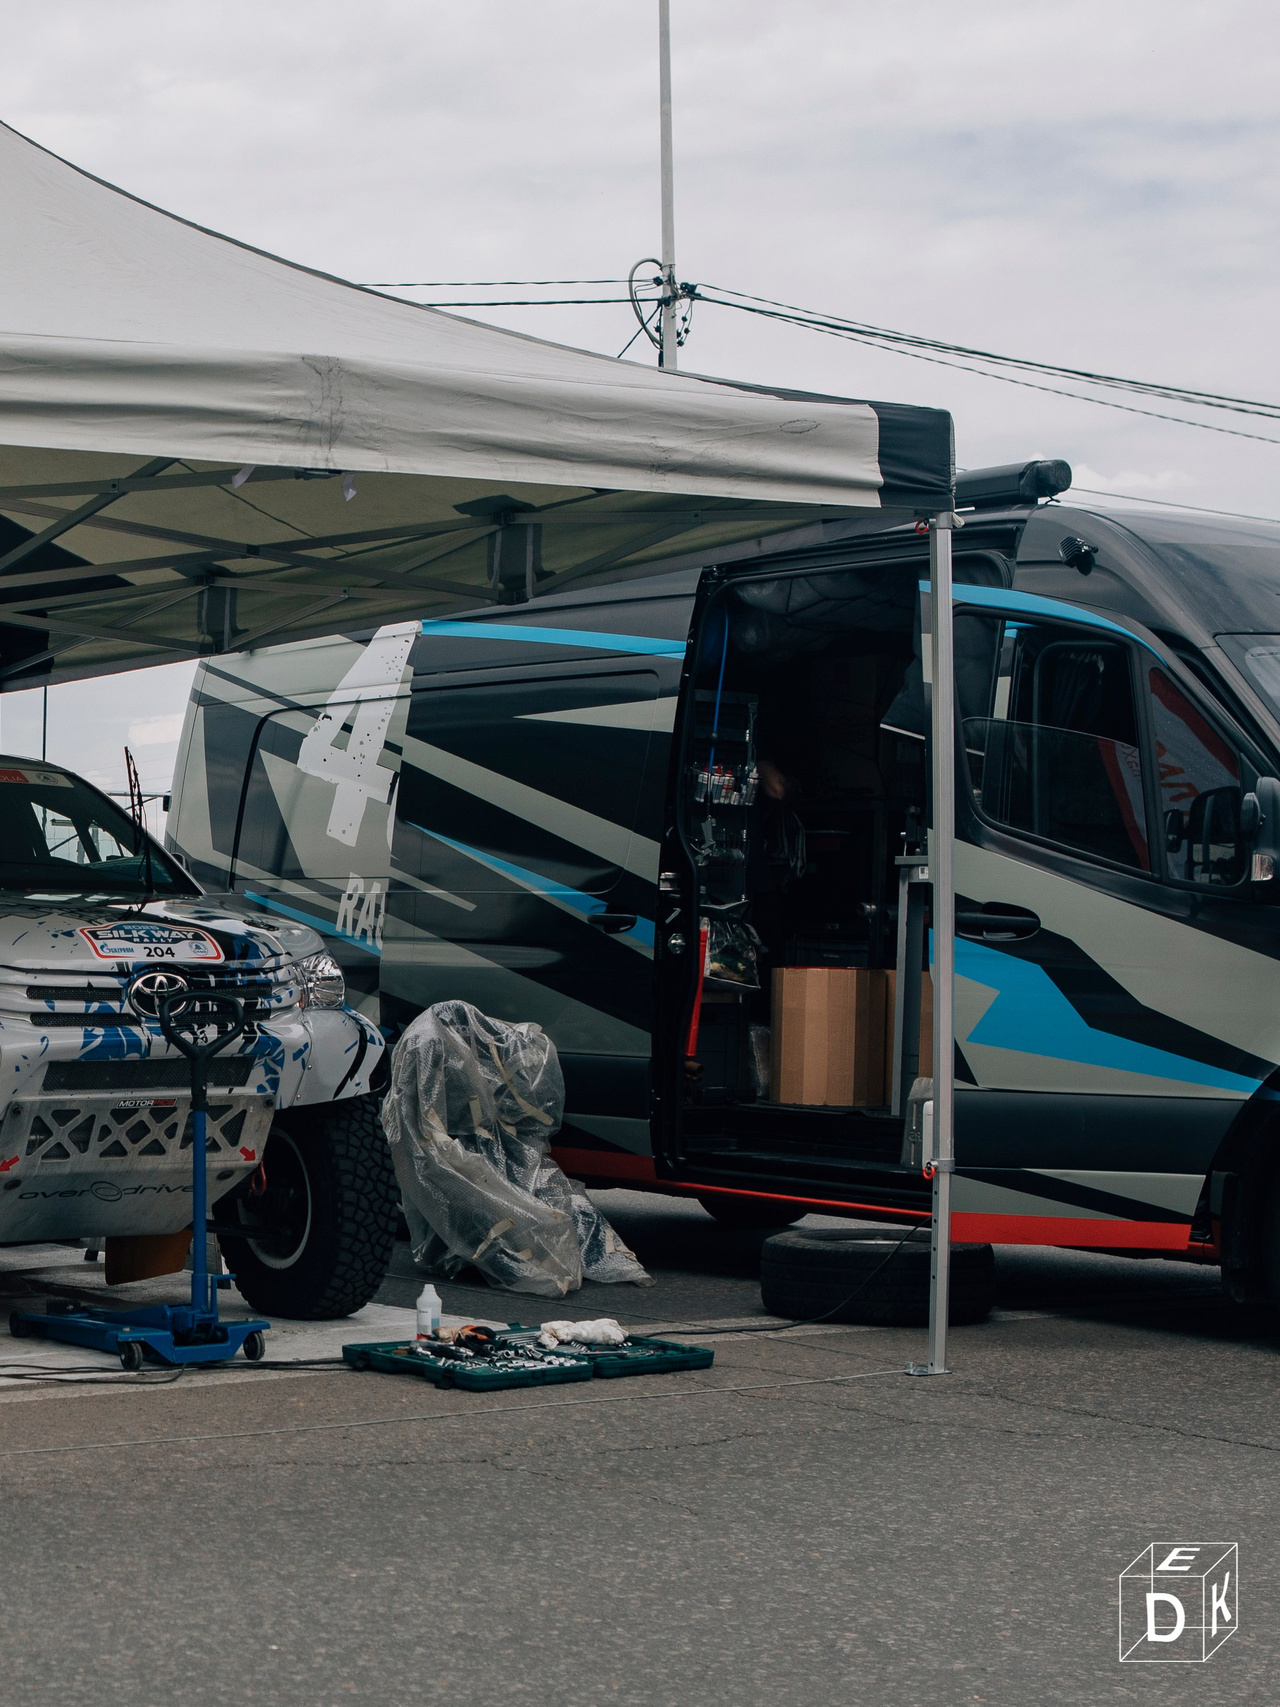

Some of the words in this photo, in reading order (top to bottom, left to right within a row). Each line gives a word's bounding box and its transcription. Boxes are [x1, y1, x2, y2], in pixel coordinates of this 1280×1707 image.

[297, 620, 420, 852] 4
[96, 930, 146, 939] SILK
[146, 930, 195, 940] WAY
[143, 946, 176, 958] 204
